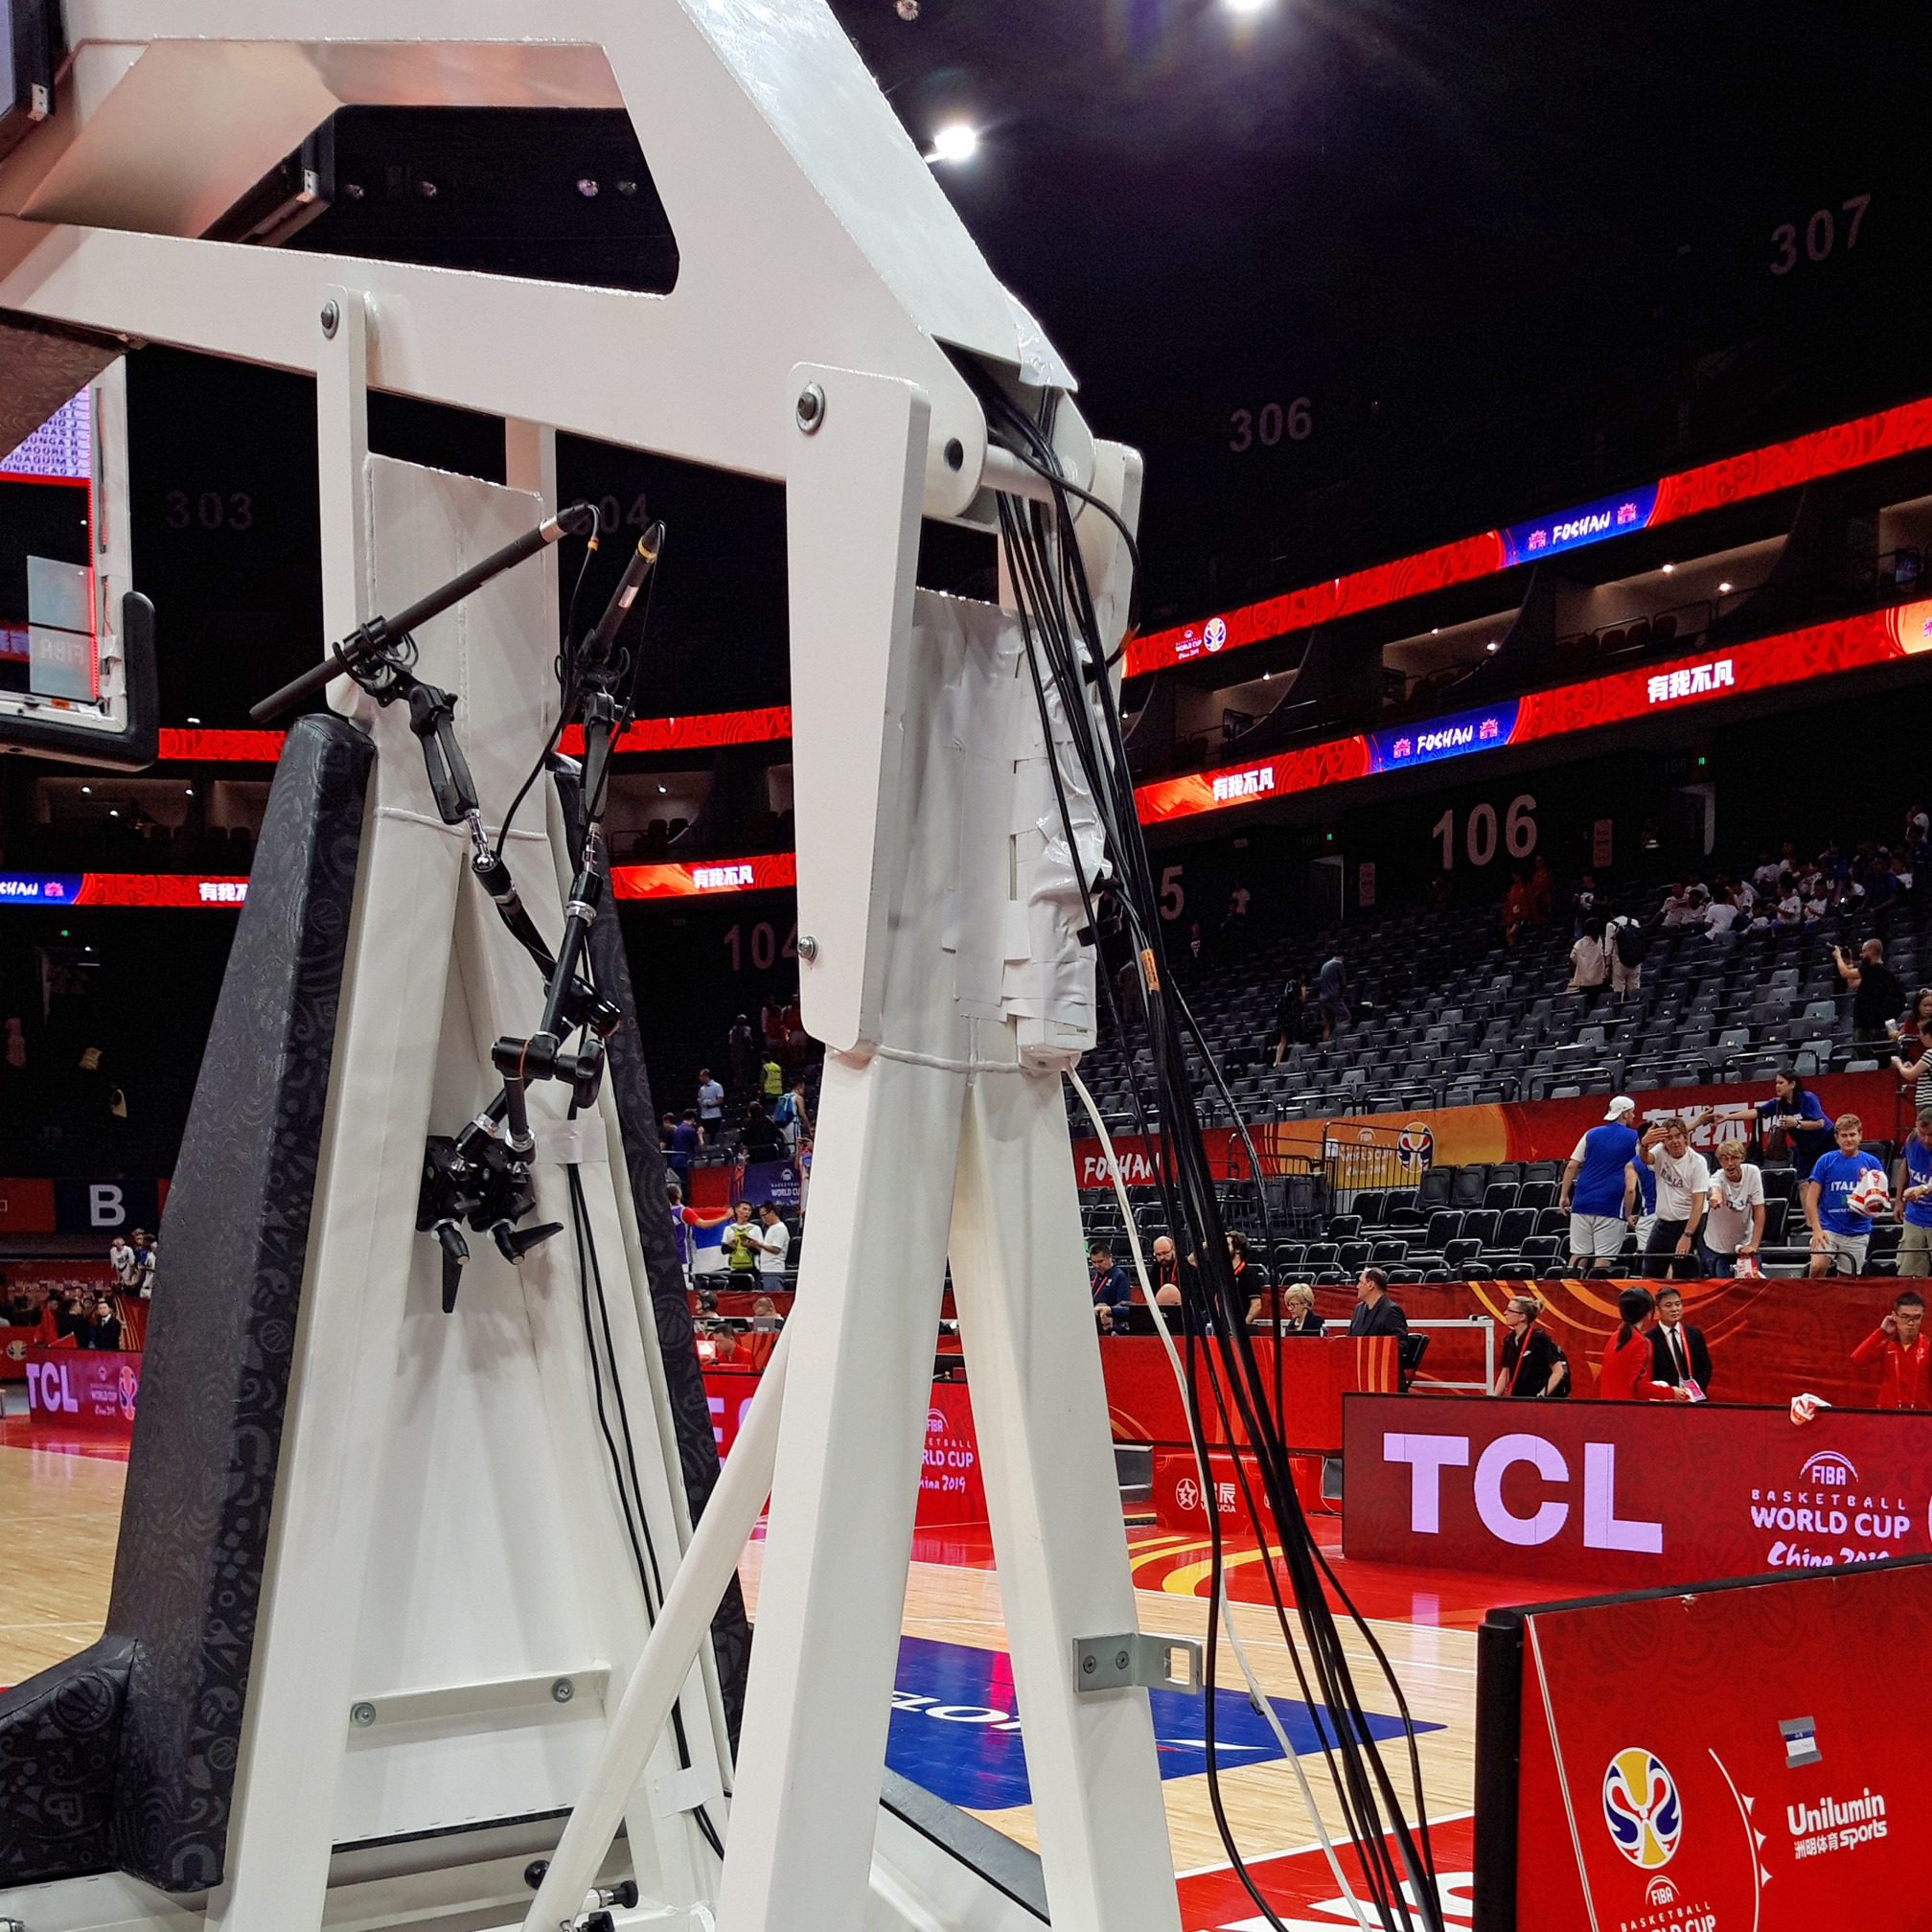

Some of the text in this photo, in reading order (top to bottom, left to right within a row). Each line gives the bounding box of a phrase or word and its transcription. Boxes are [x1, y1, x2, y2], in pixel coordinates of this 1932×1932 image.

[1769, 193, 1872, 276] 307
[1228, 397, 1313, 454] 306
[165, 491, 253, 531] 303
[1552, 511, 1611, 544] FOSHAN
[1647, 658, 1735, 703] 有我不凡
[1416, 724, 1473, 754] FOSHAN
[1212, 767, 1275, 801] 有我不凡
[1432, 794, 1538, 870] 106
[199, 883, 248, 902] 有我不
[692, 864, 754, 888] 有我不凡
[89, 1184, 126, 1227] B
[26, 1362, 79, 1413] TCL
[922, 1449, 974, 1468] RLD CUP
[1811, 1465, 1846, 1485] FIBA
[942, 1474, 966, 1494] 2019
[1383, 1432, 1663, 1554] TCL
[1751, 1489, 1906, 1511] BASKETBALL
[1751, 1506, 1910, 1539] WORLD CUP
[1787, 1787, 1886, 1836] Unilumin
[1794, 1819, 1887, 1860] 洲明体育 sports
[1650, 1886, 1674, 1906] FIBA
[1621, 1900, 1711, 1932] BASKETBALL
